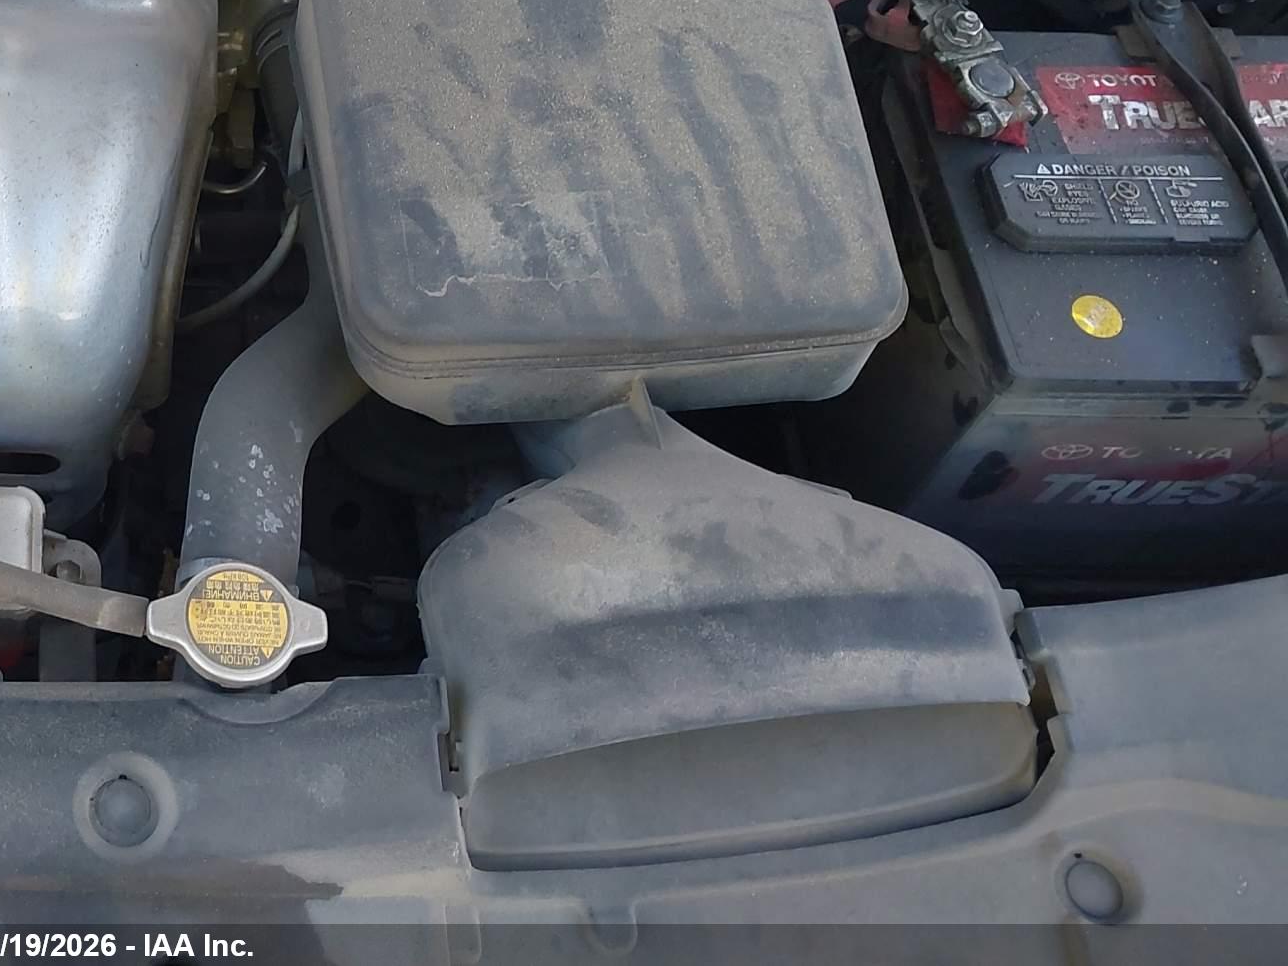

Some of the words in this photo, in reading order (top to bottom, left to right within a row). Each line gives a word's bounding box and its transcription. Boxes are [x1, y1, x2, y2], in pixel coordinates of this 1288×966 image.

[1052, 164, 1117, 176] DANGER
[1133, 165, 1191, 176] POISON
[208, 644, 259, 656] ATTENTION
[220, 654, 261, 666] CAUTION
